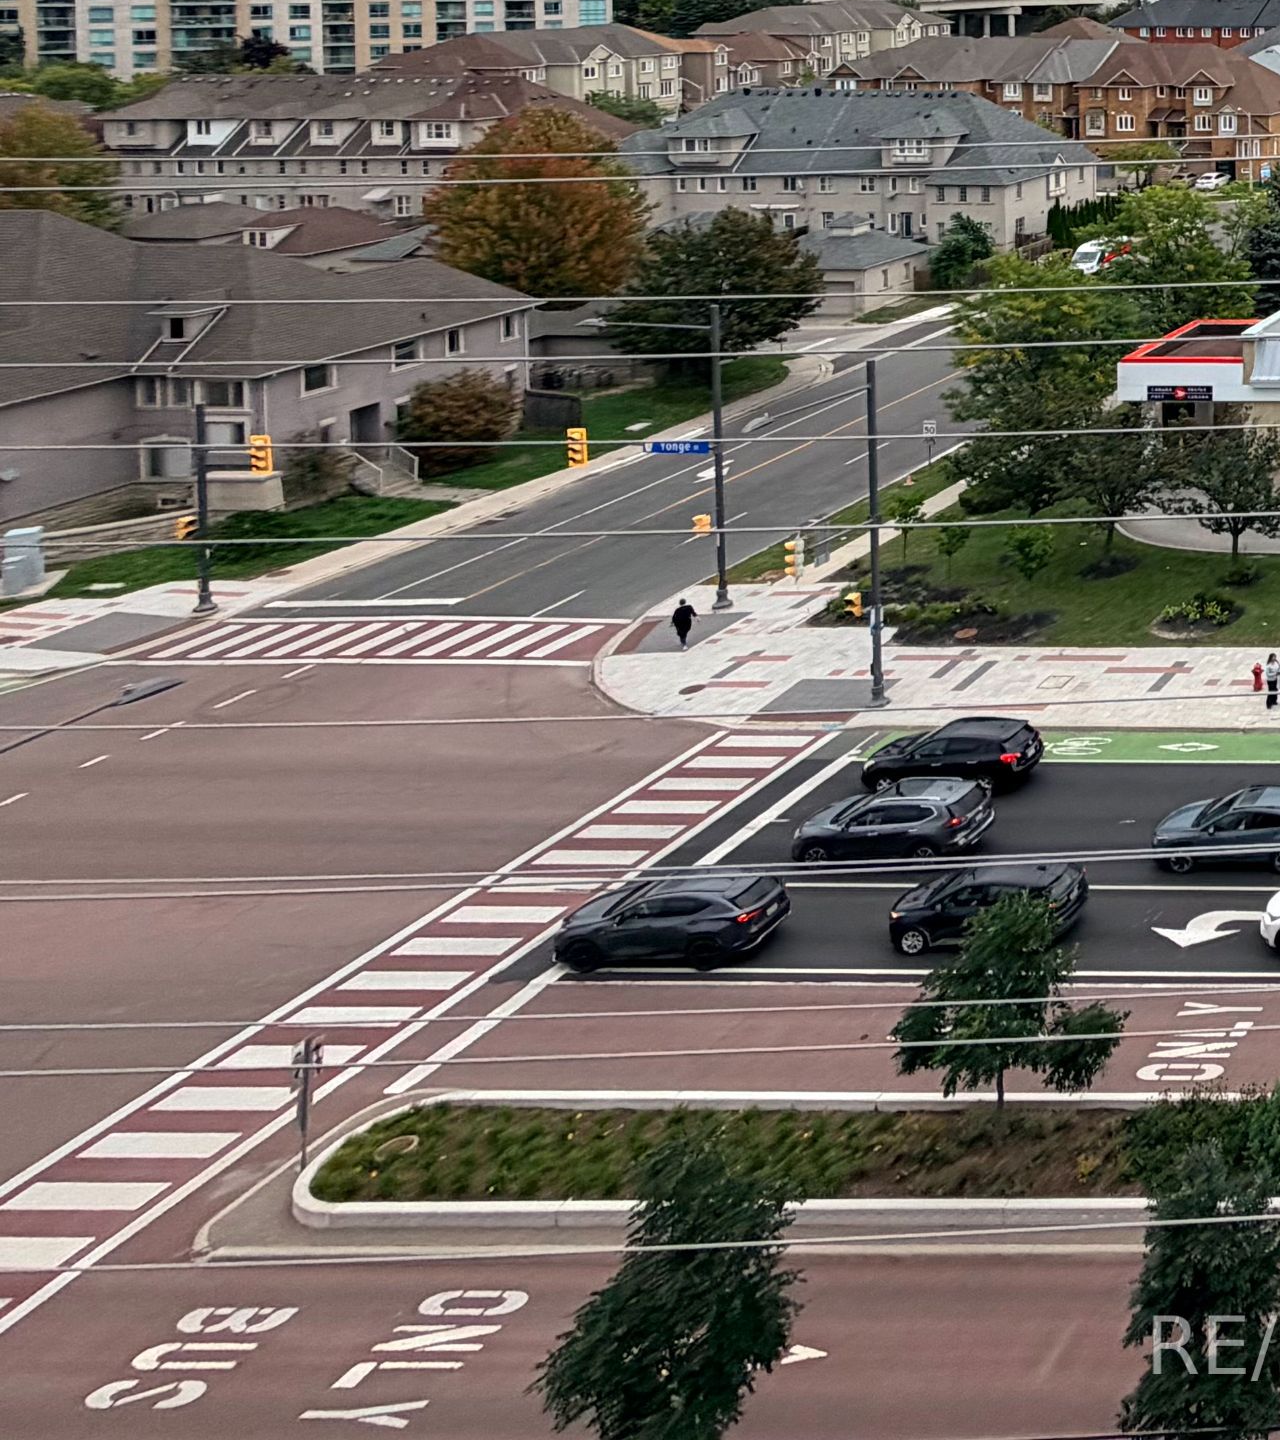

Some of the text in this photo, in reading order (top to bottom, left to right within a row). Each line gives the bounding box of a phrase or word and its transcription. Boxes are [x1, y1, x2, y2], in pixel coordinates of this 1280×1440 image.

[661, 442, 691, 453] Yonge
[1136, 1002, 1263, 1081] ONLY
[84, 1306, 299, 1410] BUS
[299, 1289, 529, 1428] ONLY
